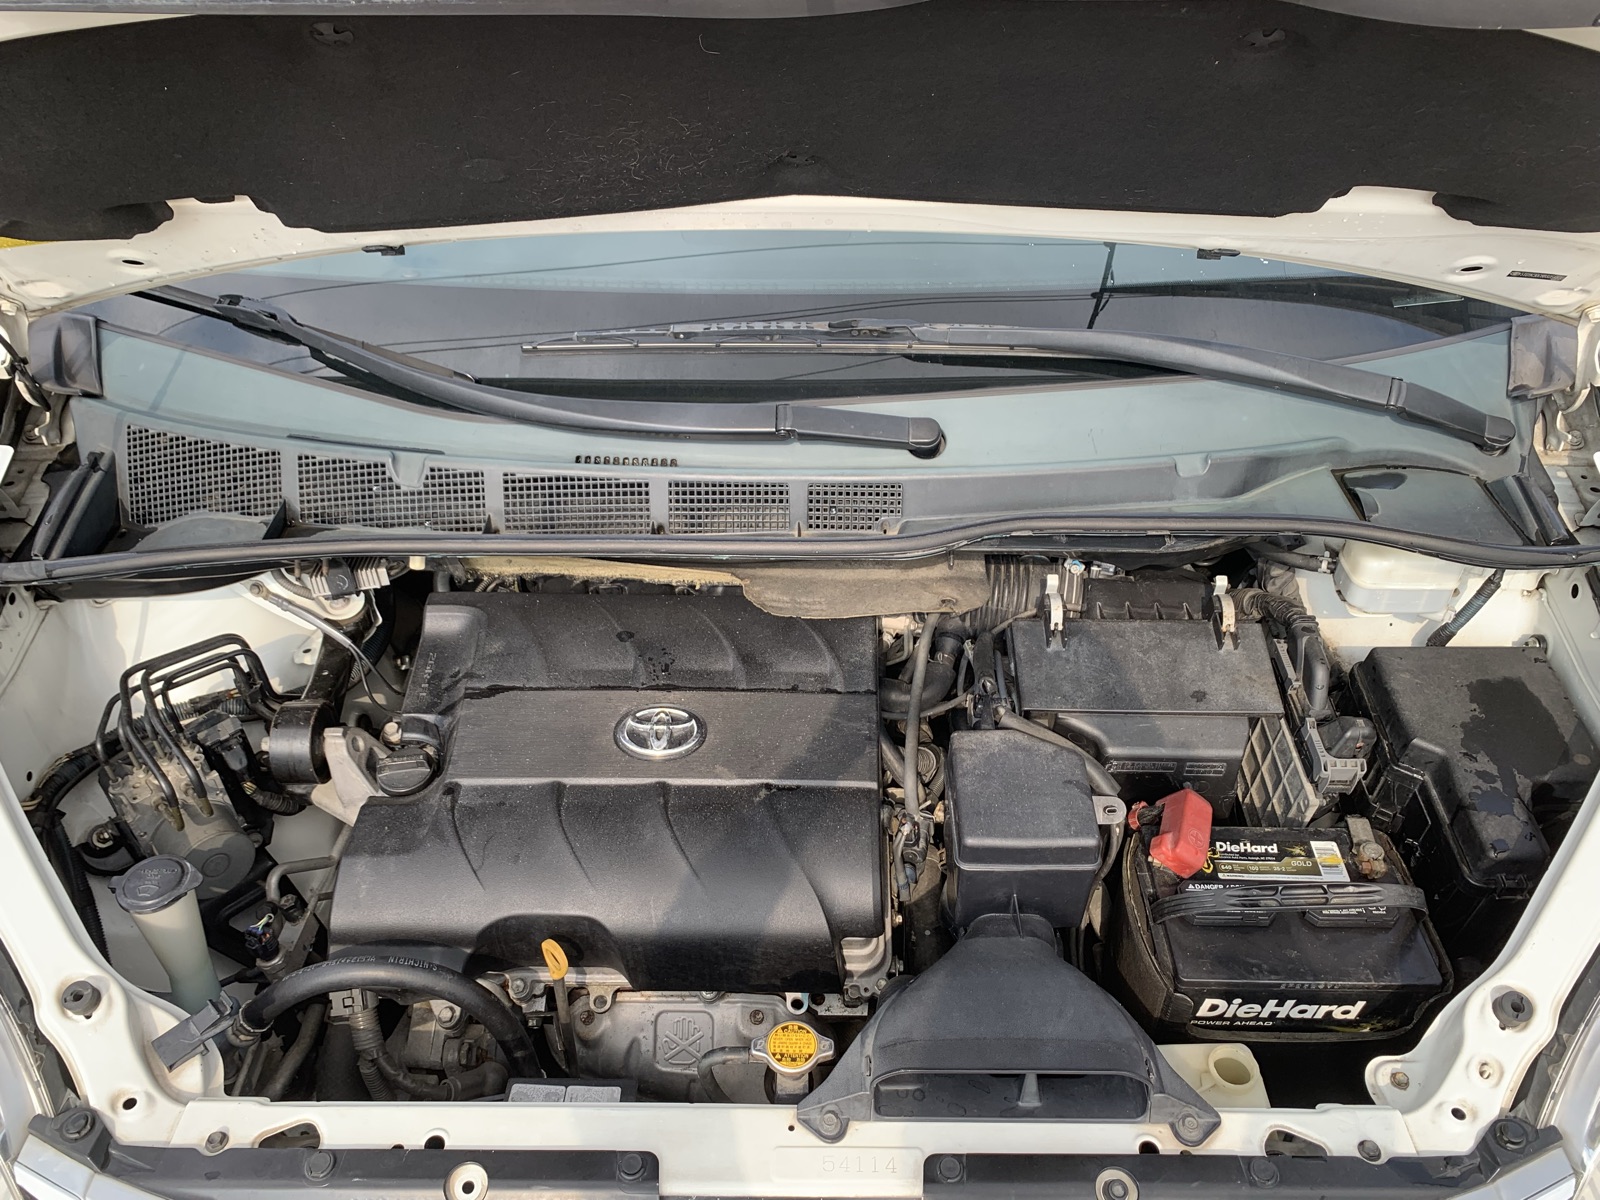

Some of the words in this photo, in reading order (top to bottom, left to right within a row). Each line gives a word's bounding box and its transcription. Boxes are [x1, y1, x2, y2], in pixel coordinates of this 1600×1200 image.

[1215, 841, 1278, 854] DieHard
[1290, 859, 1312, 867] GOLD
[1195, 998, 1367, 1020] DieHard
[822, 1155, 898, 1174] 54114
